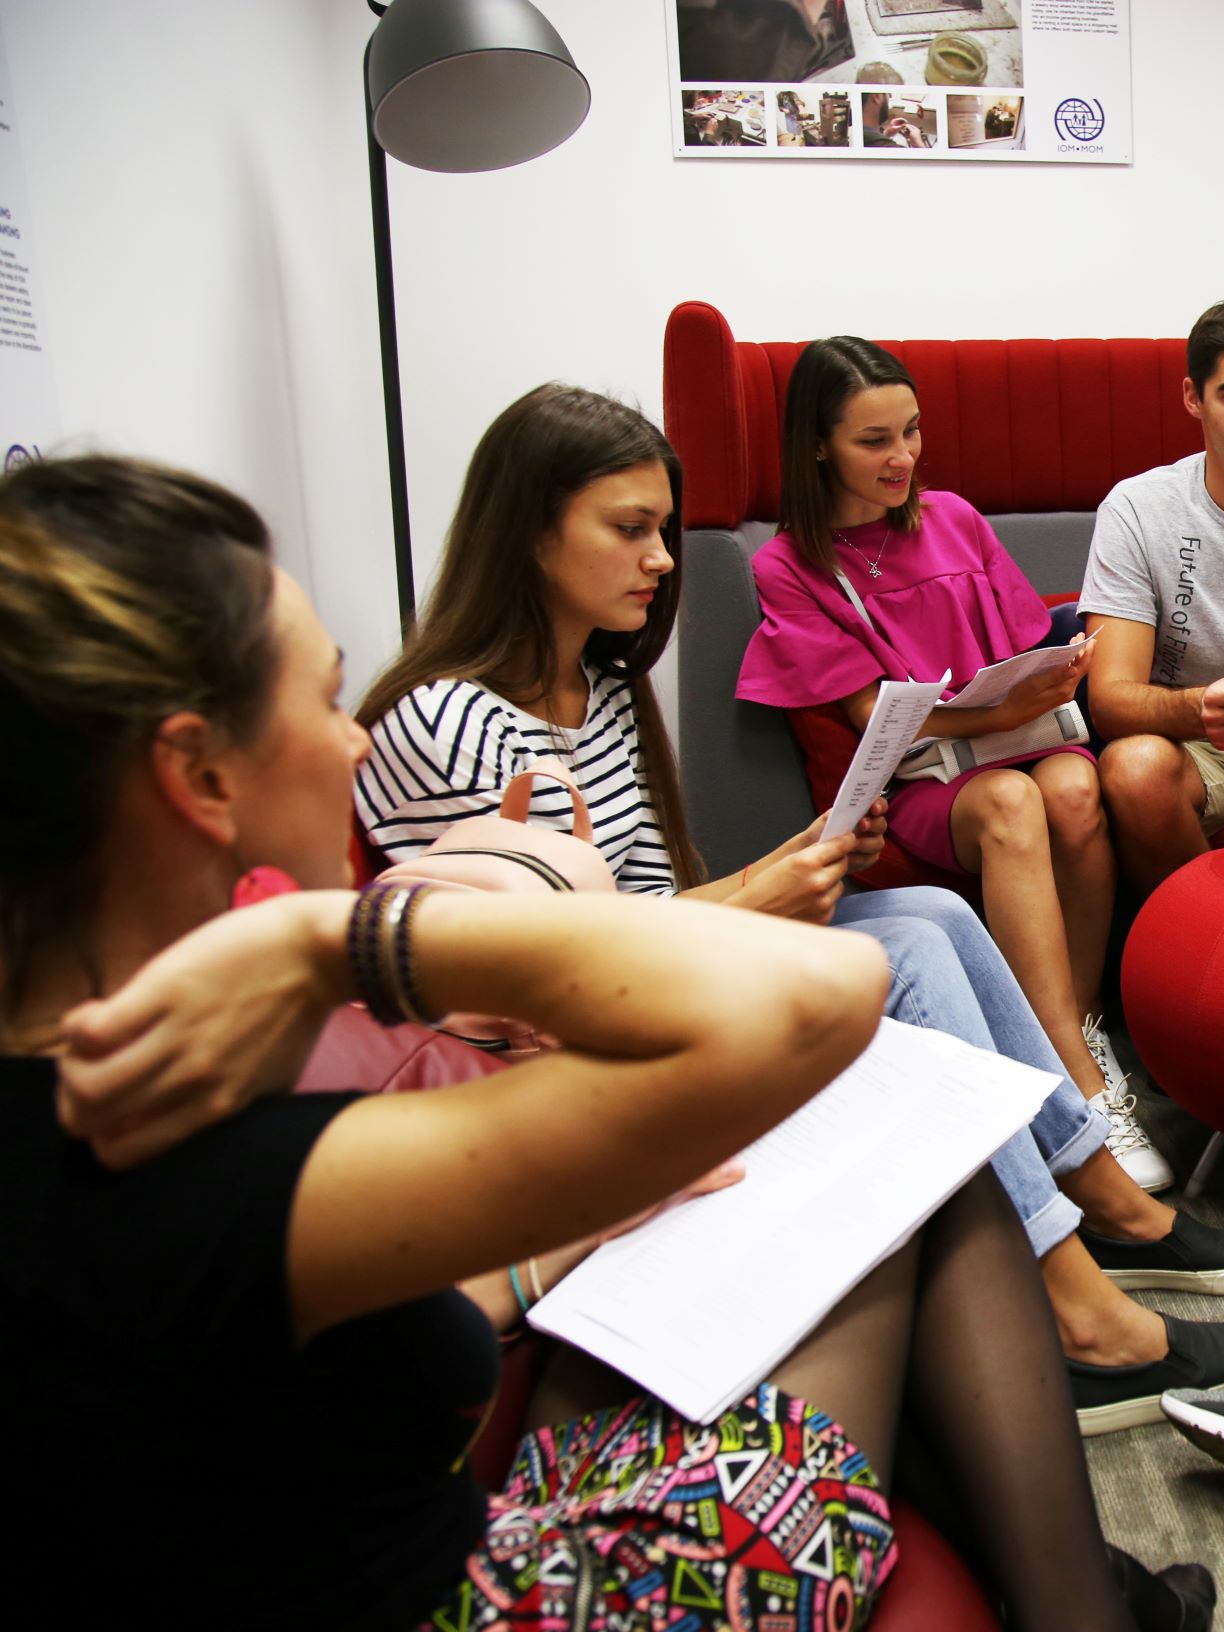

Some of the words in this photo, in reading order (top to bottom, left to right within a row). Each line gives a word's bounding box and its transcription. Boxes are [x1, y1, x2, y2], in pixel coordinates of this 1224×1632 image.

[1174, 536, 1201, 606] Future
[1170, 611, 1191, 636] of
[1160, 635, 1188, 682] Flight
